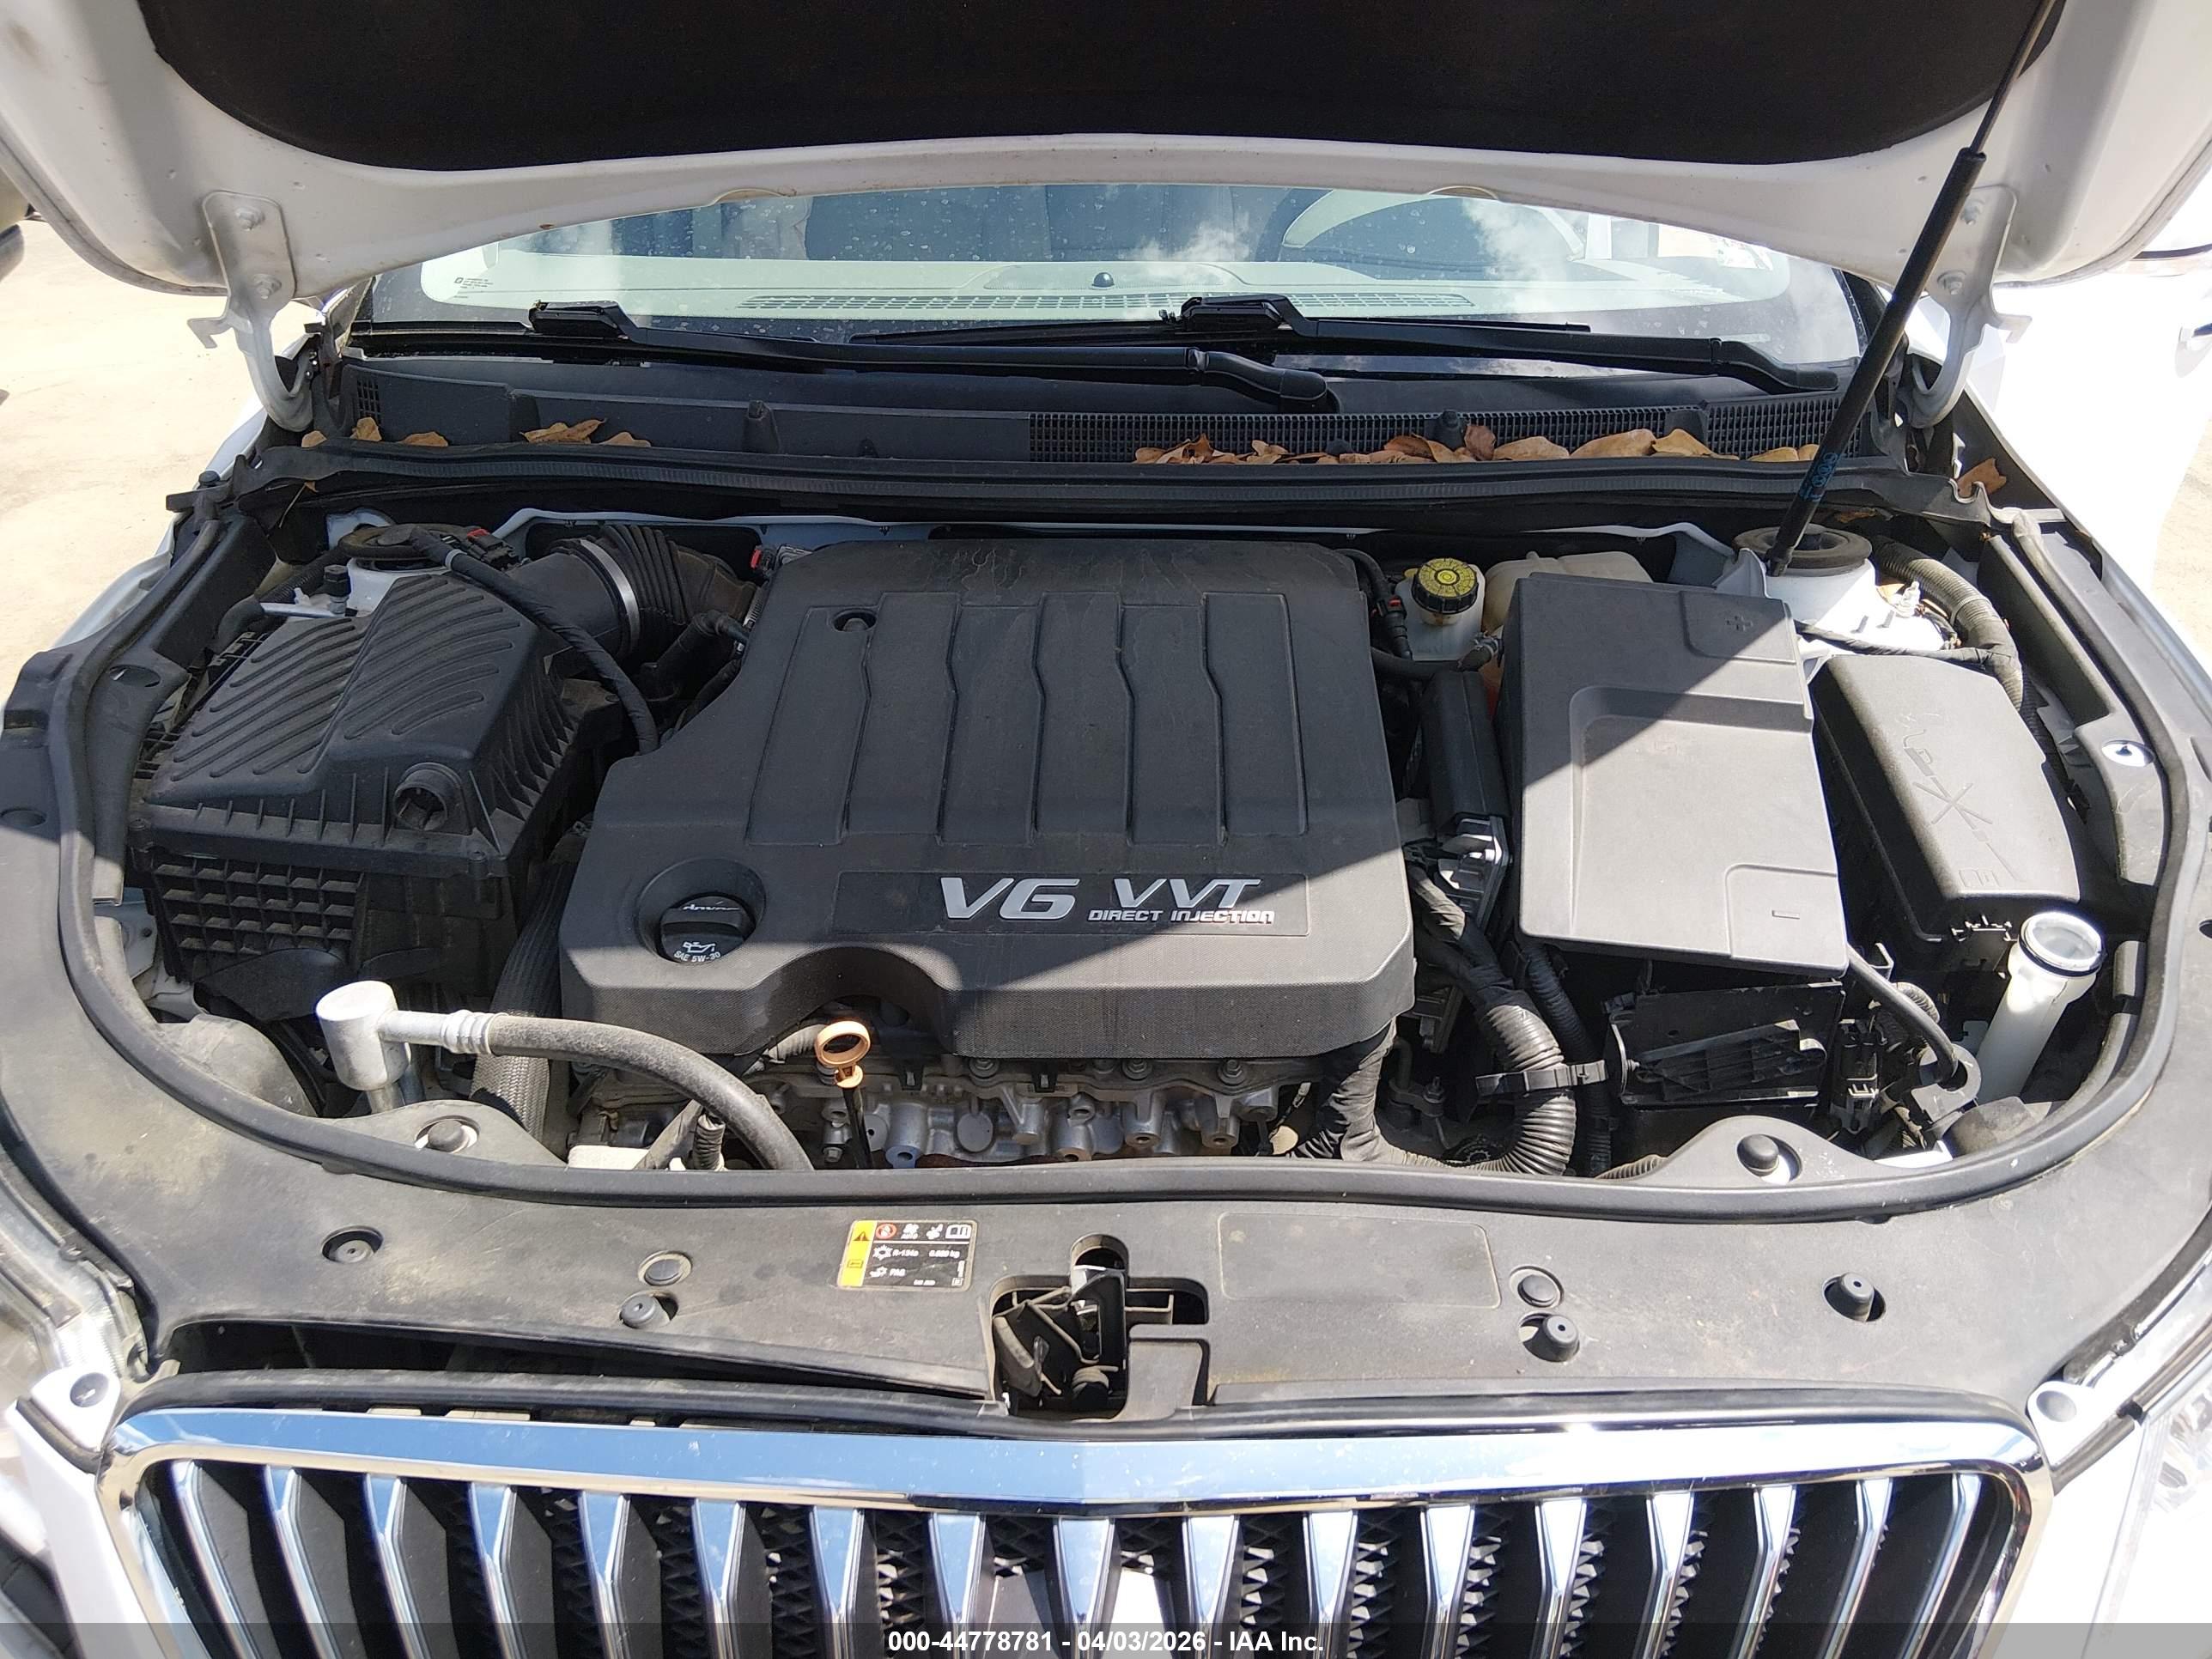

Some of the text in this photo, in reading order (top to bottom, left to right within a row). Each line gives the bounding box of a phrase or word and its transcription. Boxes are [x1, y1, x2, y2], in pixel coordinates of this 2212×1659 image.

[940, 877, 1080, 921] V6
[1113, 878, 1261, 908] VVT
[1088, 909, 1275, 924] DIRECT INJECTION
[674, 951, 720, 963] SAE 5W-30
